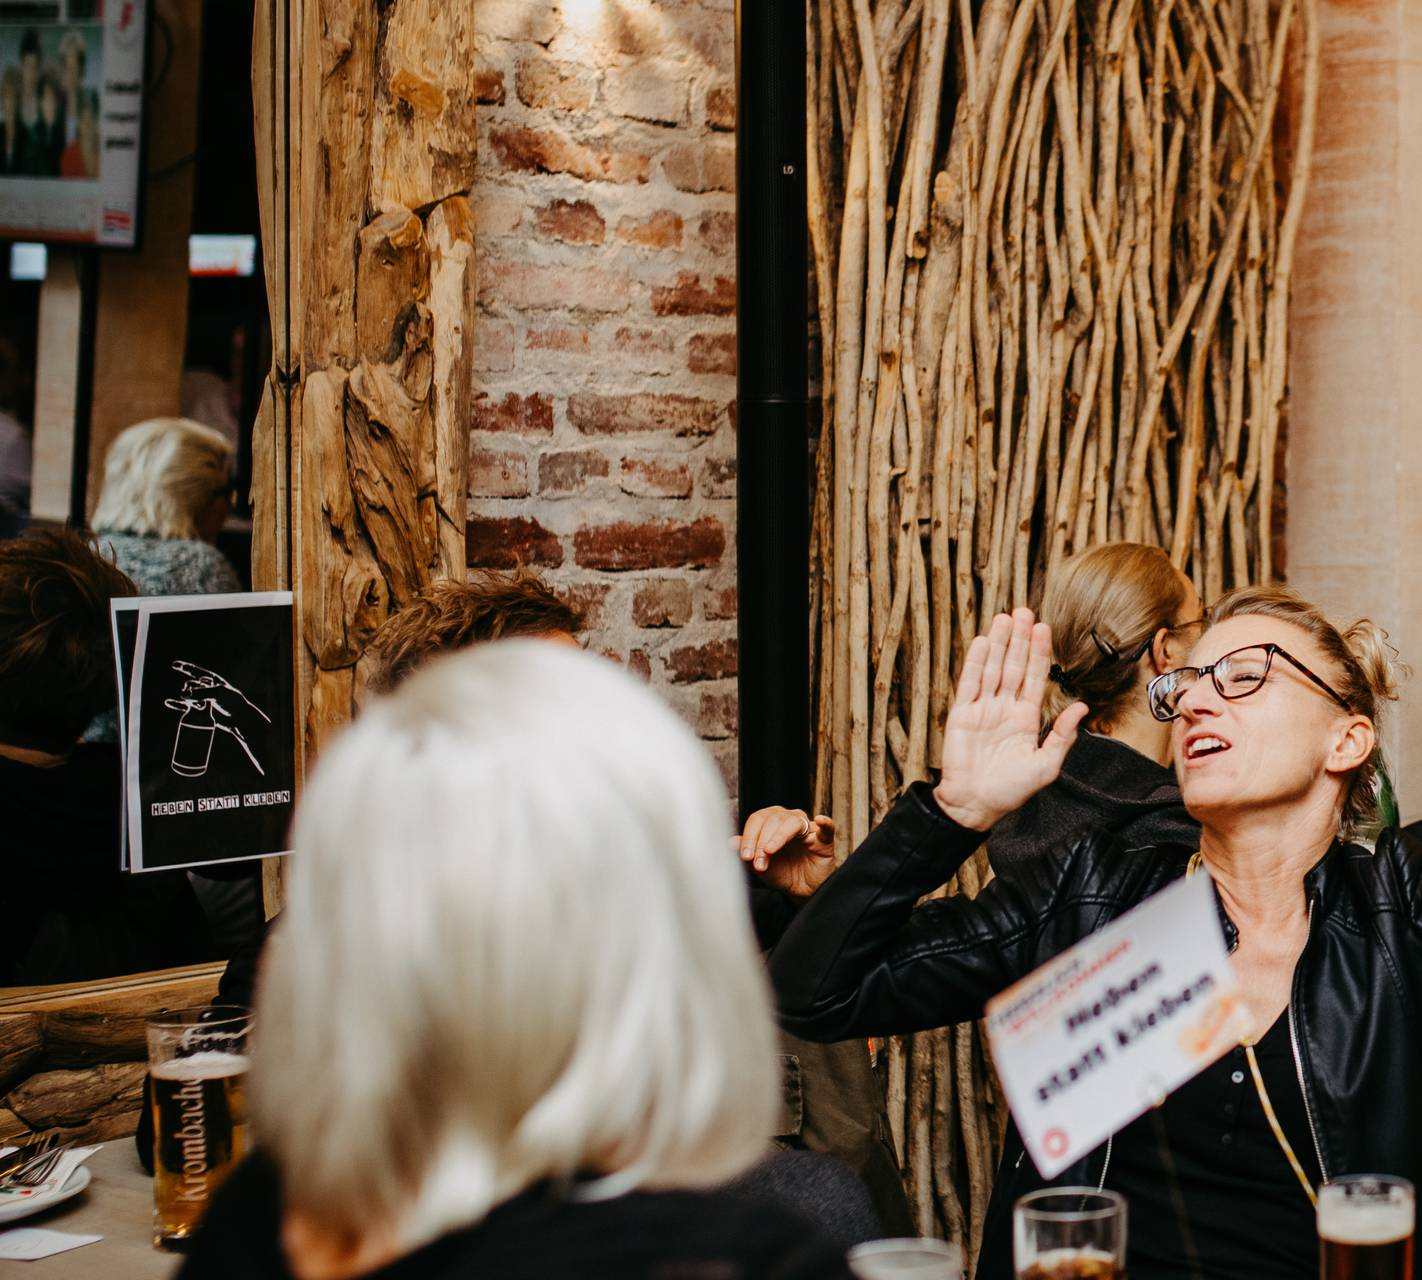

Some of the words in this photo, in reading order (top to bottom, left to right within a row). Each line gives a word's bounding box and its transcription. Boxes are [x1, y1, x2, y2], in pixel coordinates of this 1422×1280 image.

[151, 800, 194, 816] HEBEN
[198, 795, 240, 812] STATT
[243, 790, 291, 807] KLEBEN
